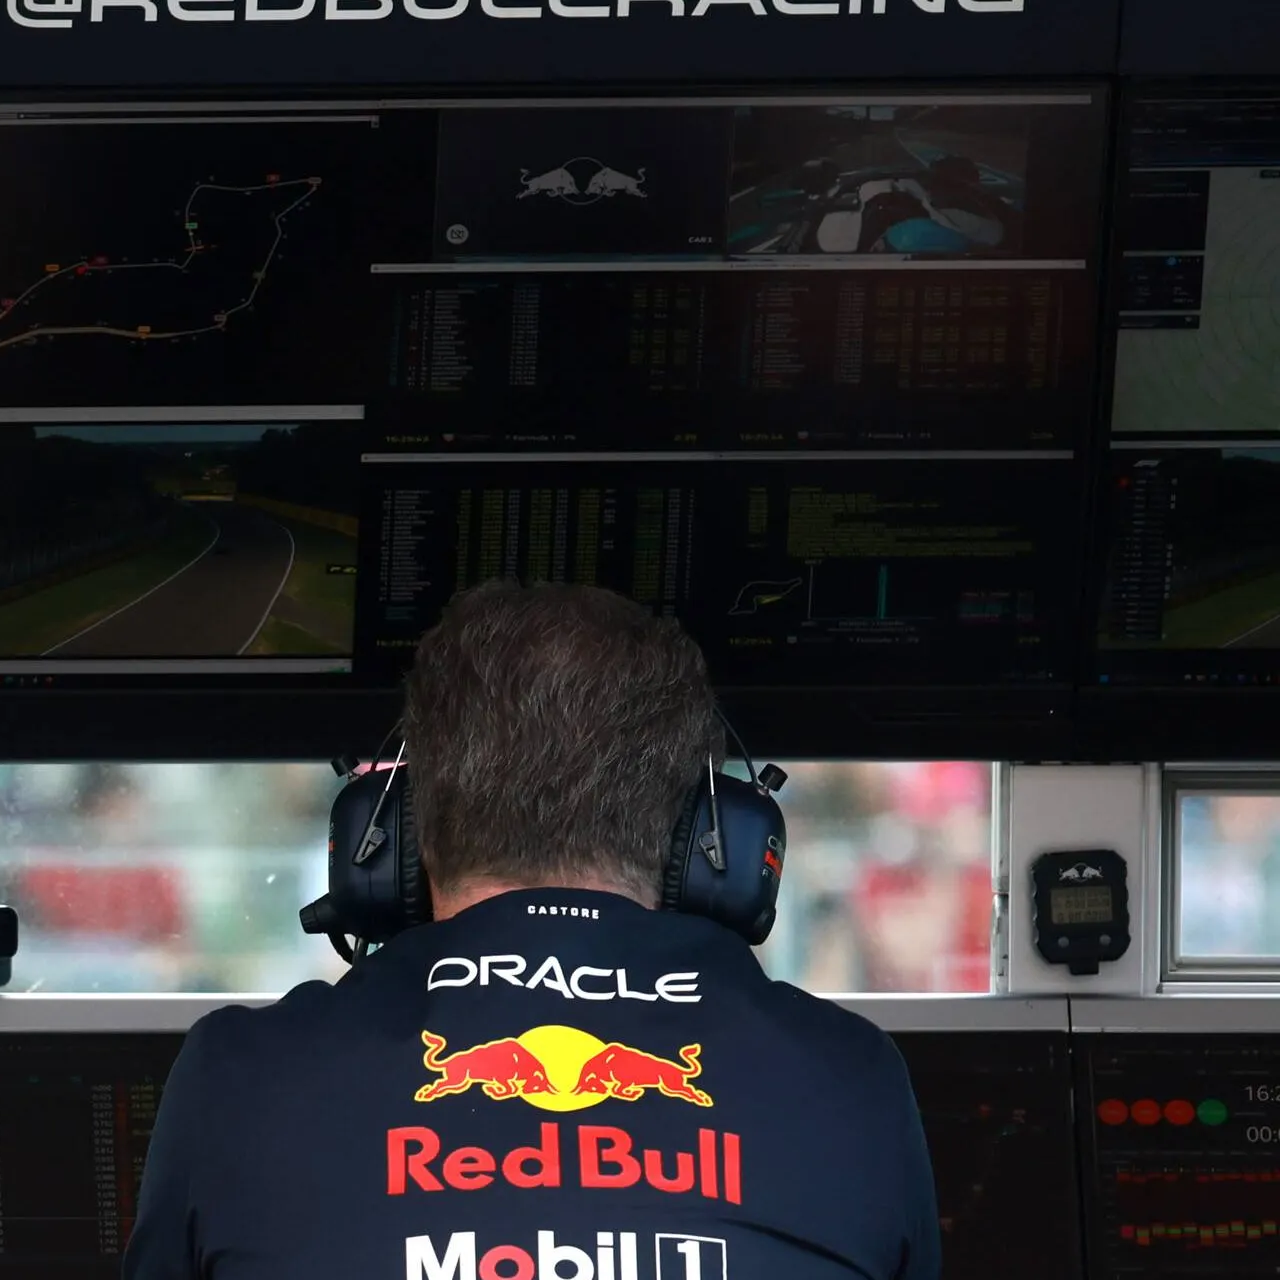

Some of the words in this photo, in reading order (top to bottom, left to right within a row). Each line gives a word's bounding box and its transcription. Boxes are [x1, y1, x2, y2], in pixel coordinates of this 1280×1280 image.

[527, 904, 600, 920] CASTORE
[427, 954, 703, 1004] ORACLE
[386, 1122, 561, 1195] Red
[577, 1124, 742, 1205] Bull
